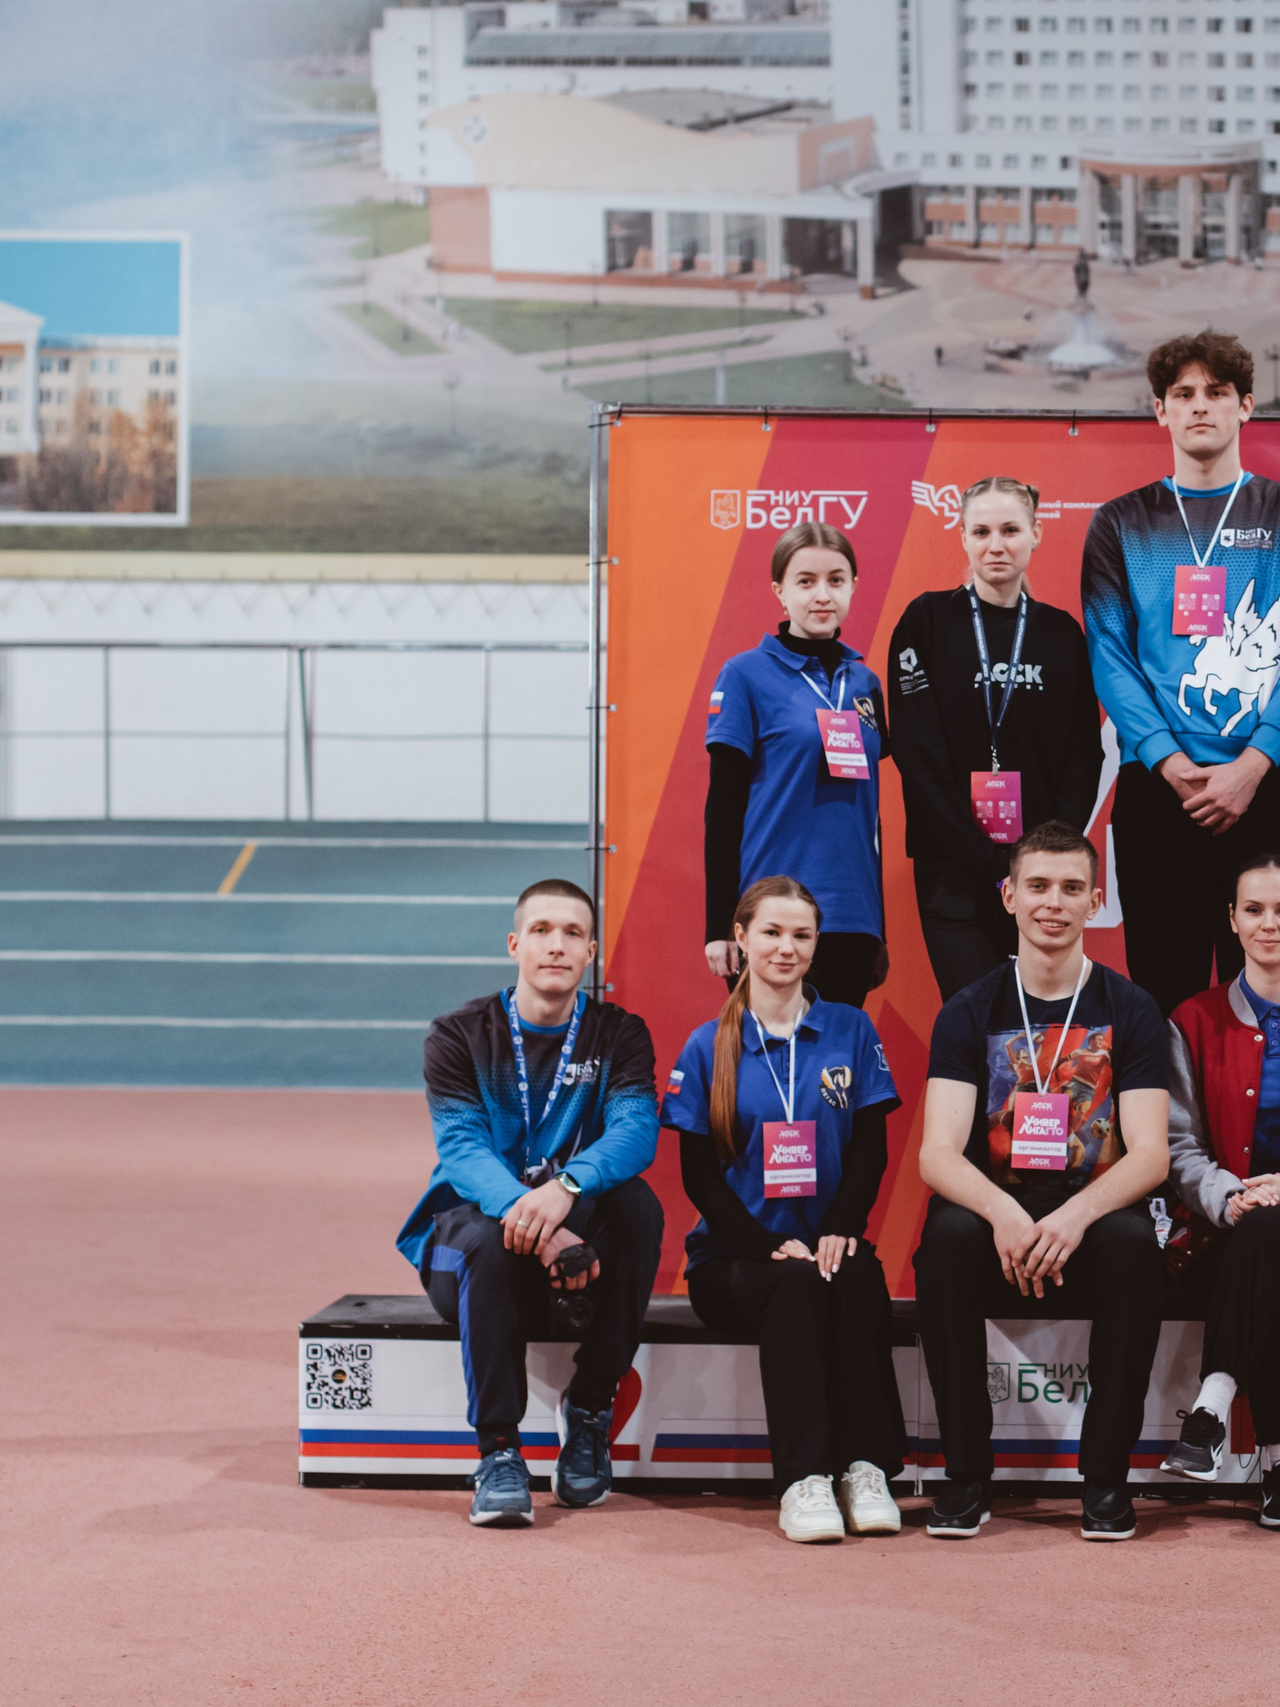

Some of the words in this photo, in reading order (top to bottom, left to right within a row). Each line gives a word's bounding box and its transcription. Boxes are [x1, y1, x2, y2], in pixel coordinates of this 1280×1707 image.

[769, 490, 813, 506] НИУ
[746, 495, 868, 530] БелГУ
[1044, 1363, 1090, 1379] НИУ
[1018, 1369, 1088, 1403] Бел
